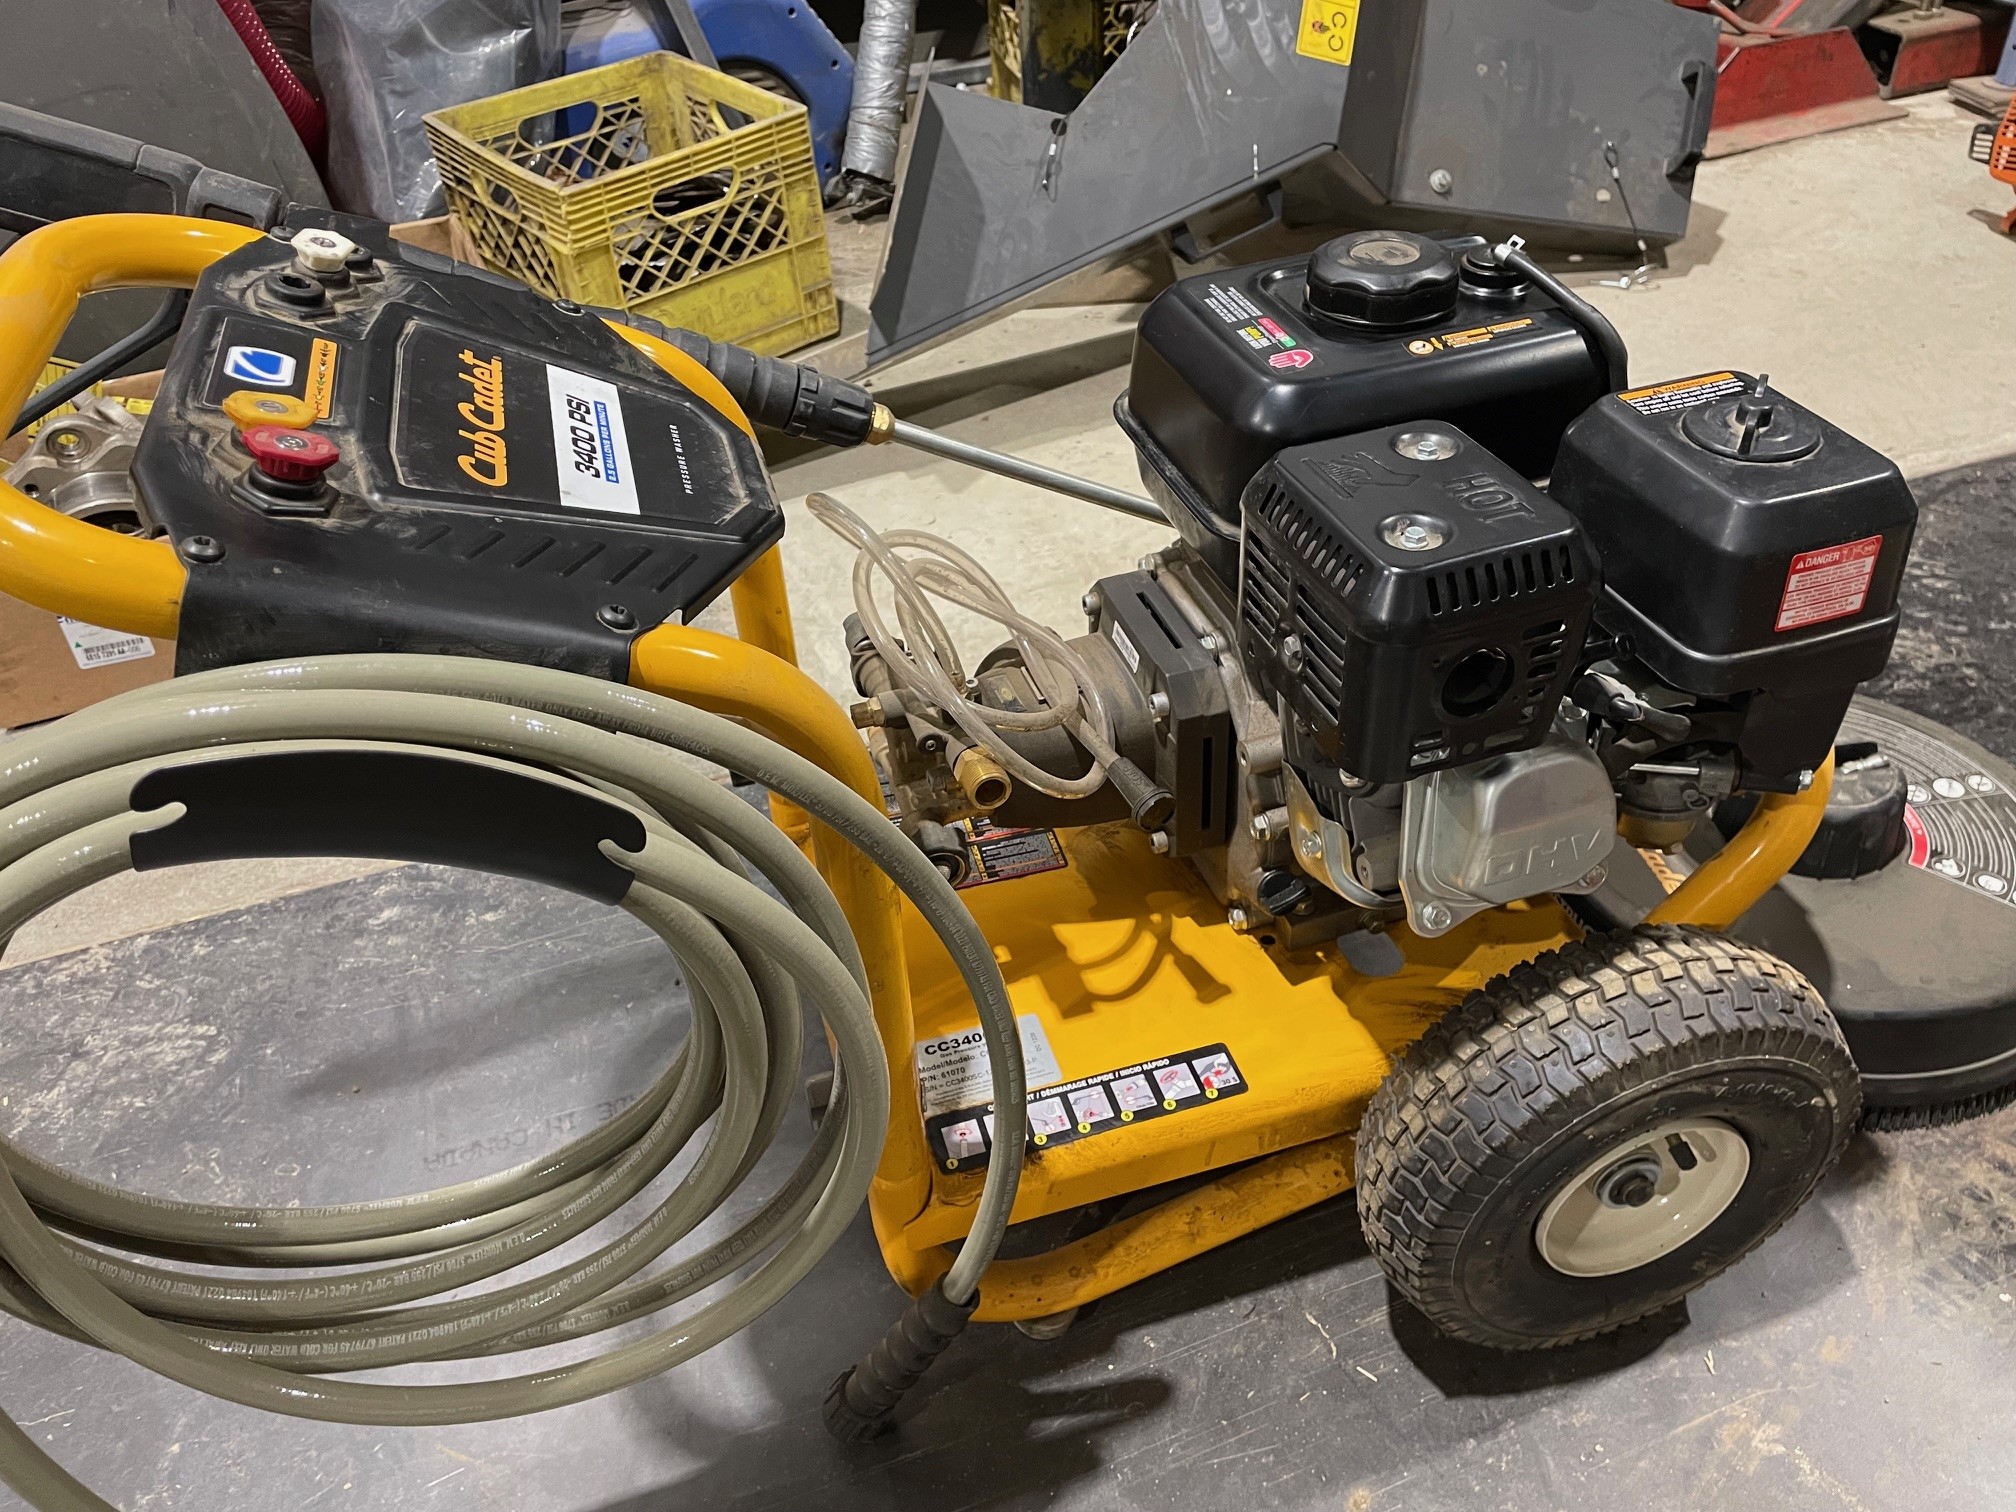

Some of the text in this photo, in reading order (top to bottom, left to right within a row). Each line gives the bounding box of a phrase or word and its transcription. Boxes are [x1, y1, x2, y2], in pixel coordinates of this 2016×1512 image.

[566, 393, 601, 478] 3400 PSI
[596, 403, 617, 481] 2.5 GALLONS PER MINUTE
[457, 429, 508, 487] Cub
[669, 424, 694, 495] PRESSURE WASHER
[1443, 472, 1537, 525] HOT
[1804, 551, 1840, 568] DANGER
[669, 733, 713, 755] SURFACES
[1484, 828, 1600, 885] OHV
[924, 1032, 984, 1056] CC340
[954, 1045, 981, 1055] Pressure
[941, 1066, 966, 1079] 61070
[945, 1069, 992, 1088] CC3400SC-1
[1088, 1072, 1115, 1086] RAPIDE
[1120, 1065, 1143, 1077] INICIO
[1143, 1058, 1170, 1071] RÁPIDO
[96, 1260, 119, 1278] COLD
[248, 1343, 269, 1354] ONLY
[270, 1344, 298, 1355] WATER
[300, 1344, 320, 1355] COLD
[321, 1342, 338, 1353] FOR
[339, 1338, 377, 1352] 6779745
[377, 1333, 406, 1348] PATENT
